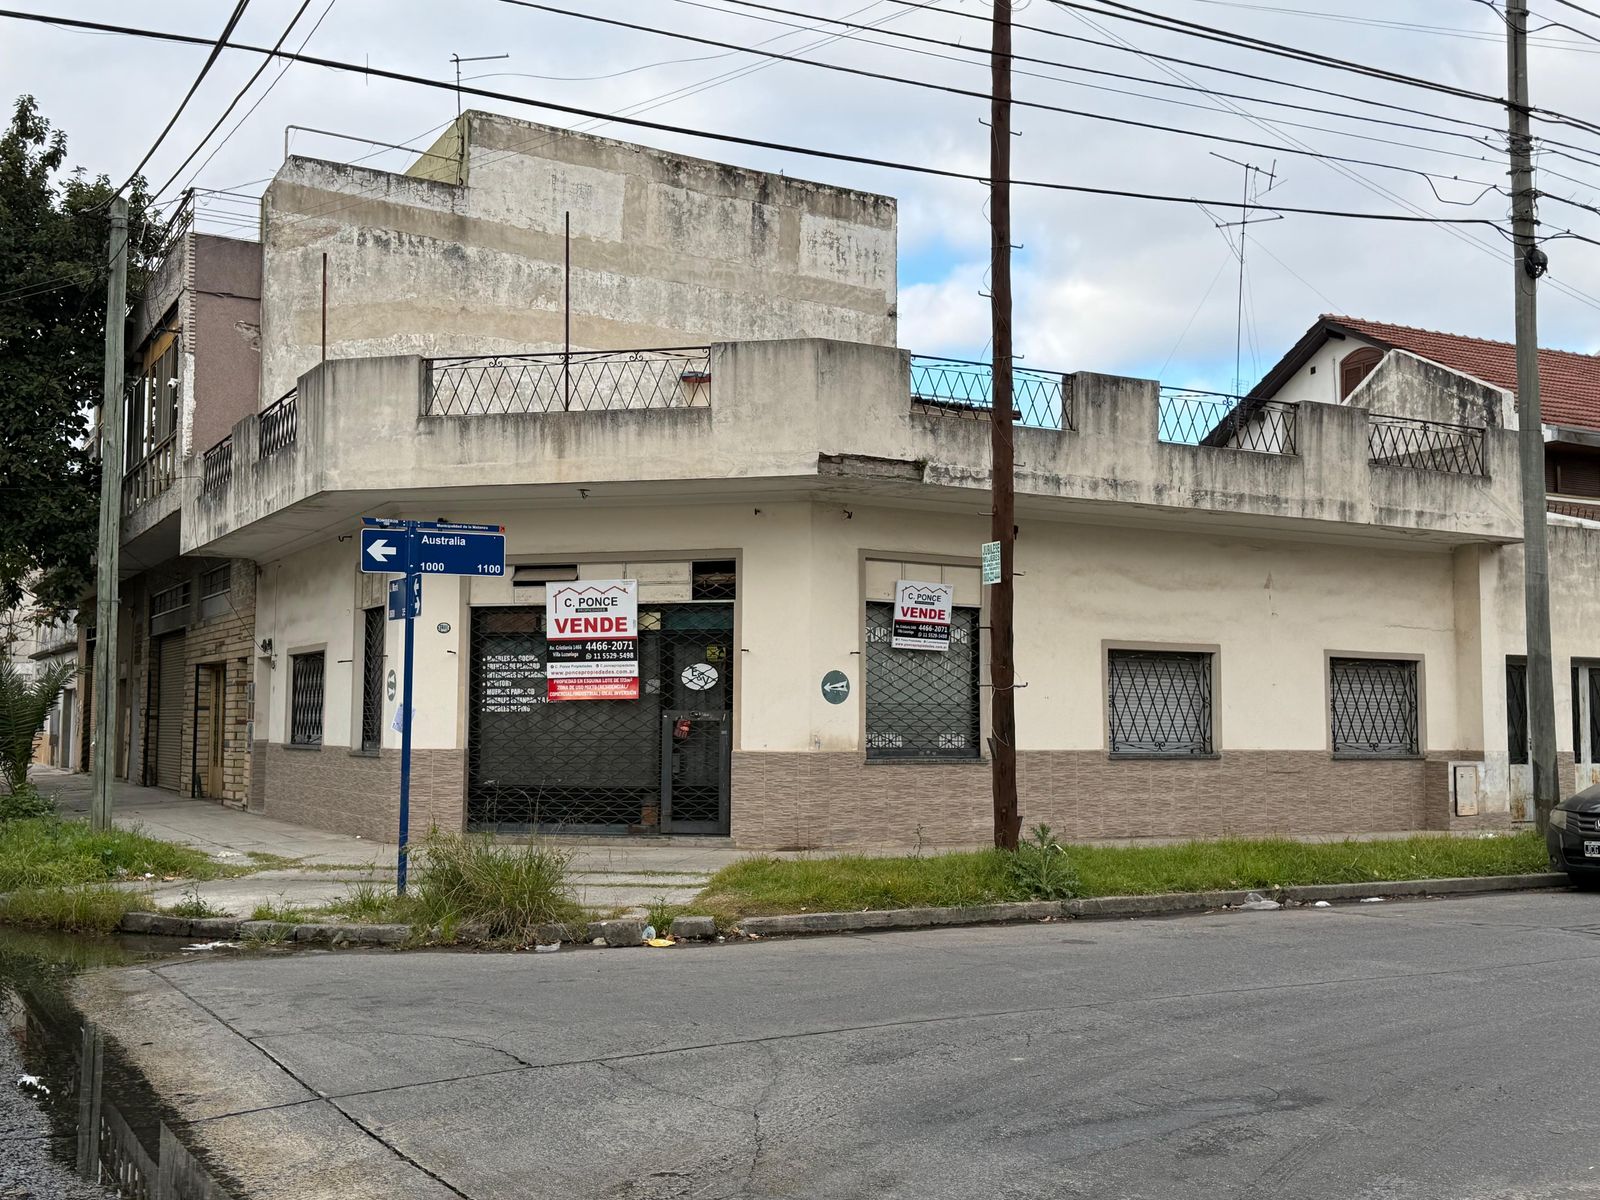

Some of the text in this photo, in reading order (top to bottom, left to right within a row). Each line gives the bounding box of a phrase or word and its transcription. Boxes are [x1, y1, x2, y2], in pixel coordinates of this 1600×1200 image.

[421, 535, 466, 546] Australia
[420, 562, 501, 573] 1000 1100
[564, 597, 618, 608] C. PONCE
[908, 592, 942, 602] C. PONCE
[901, 606, 946, 620] VENDE
[554, 617, 628, 633] VENDE
[918, 624, 948, 633] 4466-2071
[585, 640, 634, 651] 4466-2071
